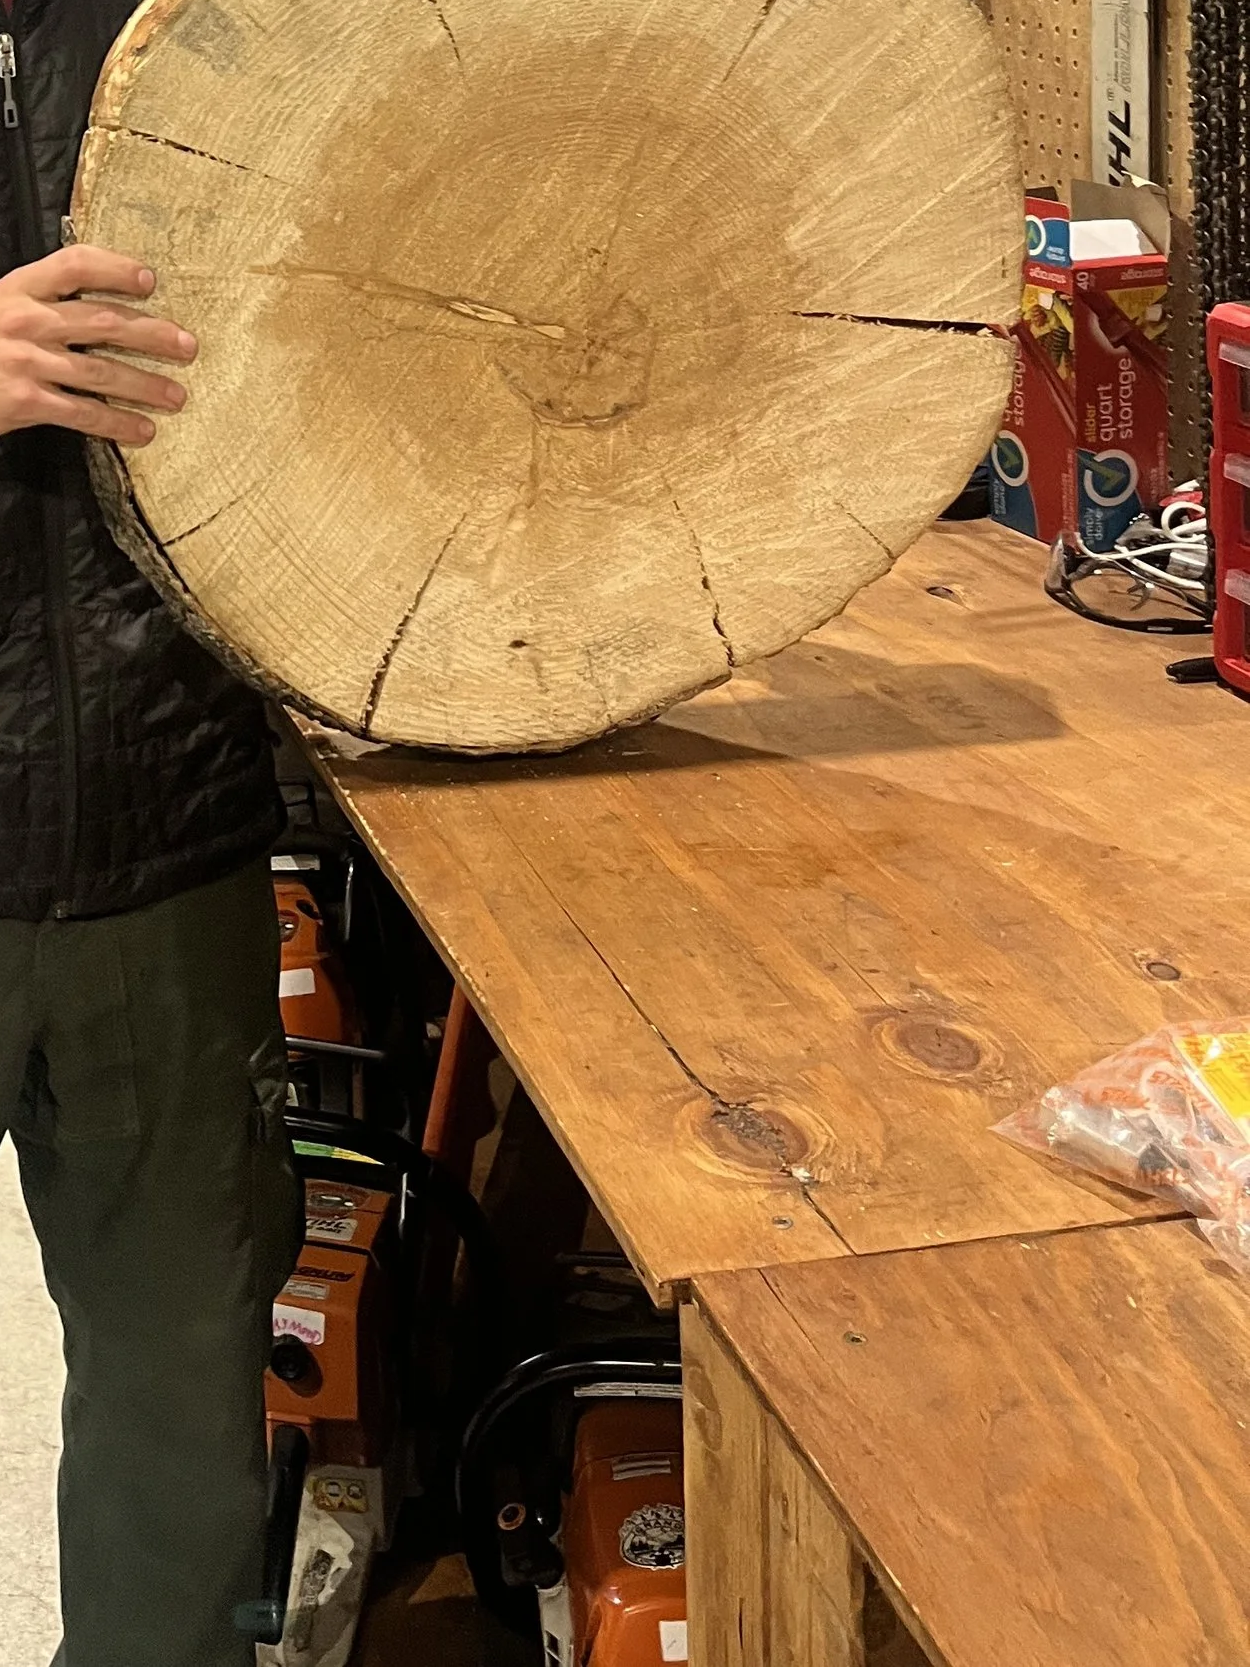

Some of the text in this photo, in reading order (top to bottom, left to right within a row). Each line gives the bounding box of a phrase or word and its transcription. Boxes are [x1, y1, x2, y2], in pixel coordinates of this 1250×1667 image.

[1076, 271, 1089, 291] 40
[1097, 382, 1118, 443] quart
[1118, 356, 1137, 440] storage
[1085, 402, 1097, 444] slider
[1084, 506, 1098, 547] simply
[1095, 508, 1105, 541] done
